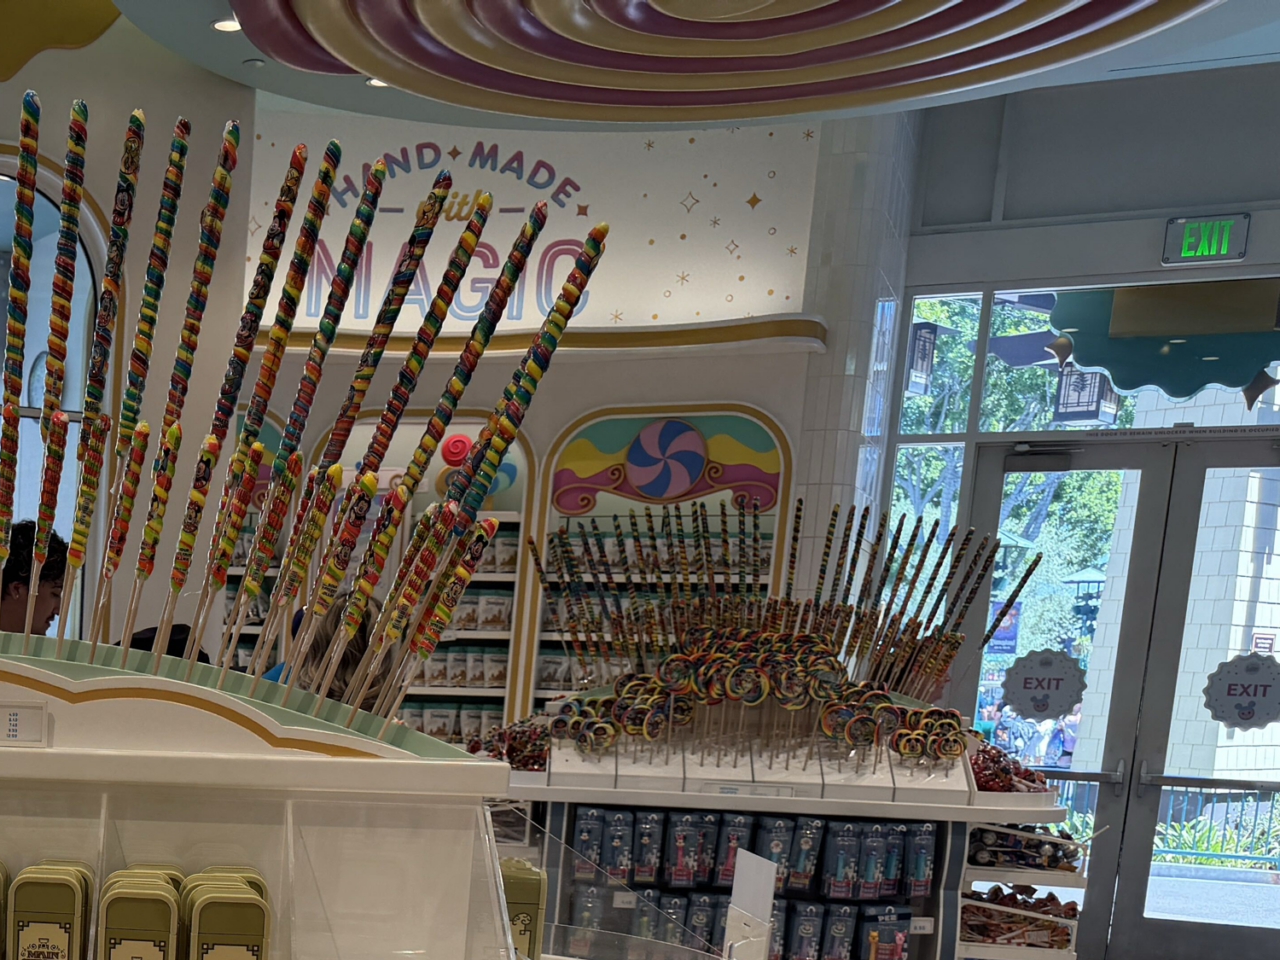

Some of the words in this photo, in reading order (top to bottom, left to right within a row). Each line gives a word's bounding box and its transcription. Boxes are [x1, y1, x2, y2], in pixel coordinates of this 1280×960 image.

[468, 141, 581, 208] MADE
[1181, 220, 1234, 257] EXIT
[1023, 677, 1064, 690] EXIT
[1227, 684, 1272, 698] EXIT
[27, 950, 60, 960] MAIN
